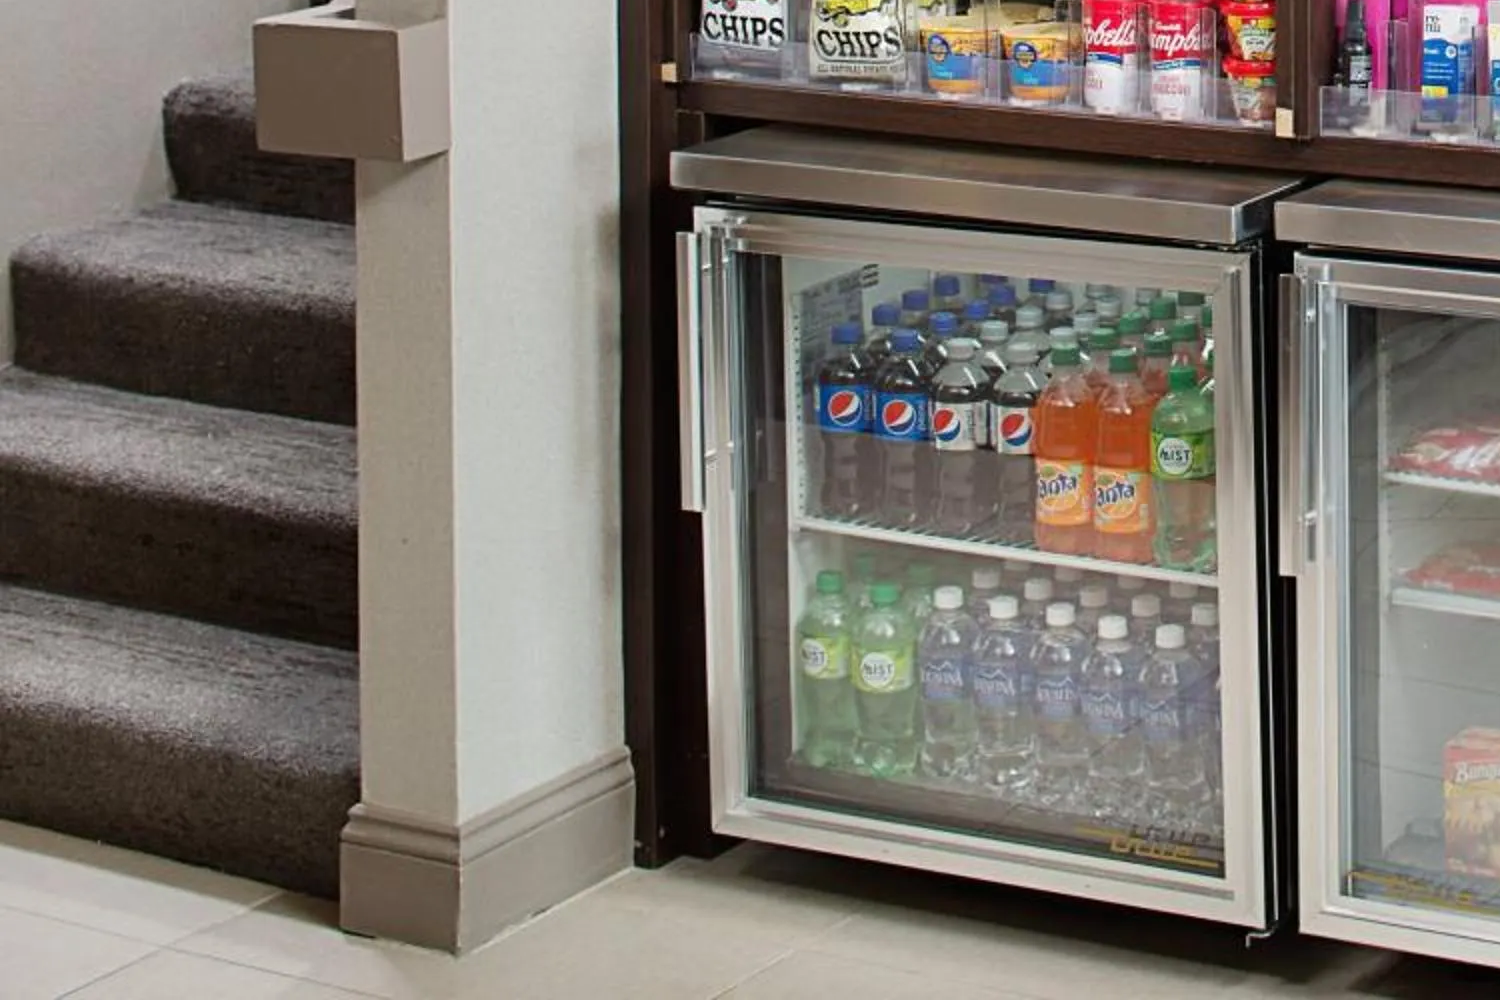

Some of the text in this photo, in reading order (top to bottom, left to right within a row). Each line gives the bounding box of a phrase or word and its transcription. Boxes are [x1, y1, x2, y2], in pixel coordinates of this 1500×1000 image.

[703, 12, 785, 47] CHIPS
[817, 26, 901, 60] CHIPS
[1039, 474, 1078, 499] anta
[1097, 481, 1135, 507] anta
